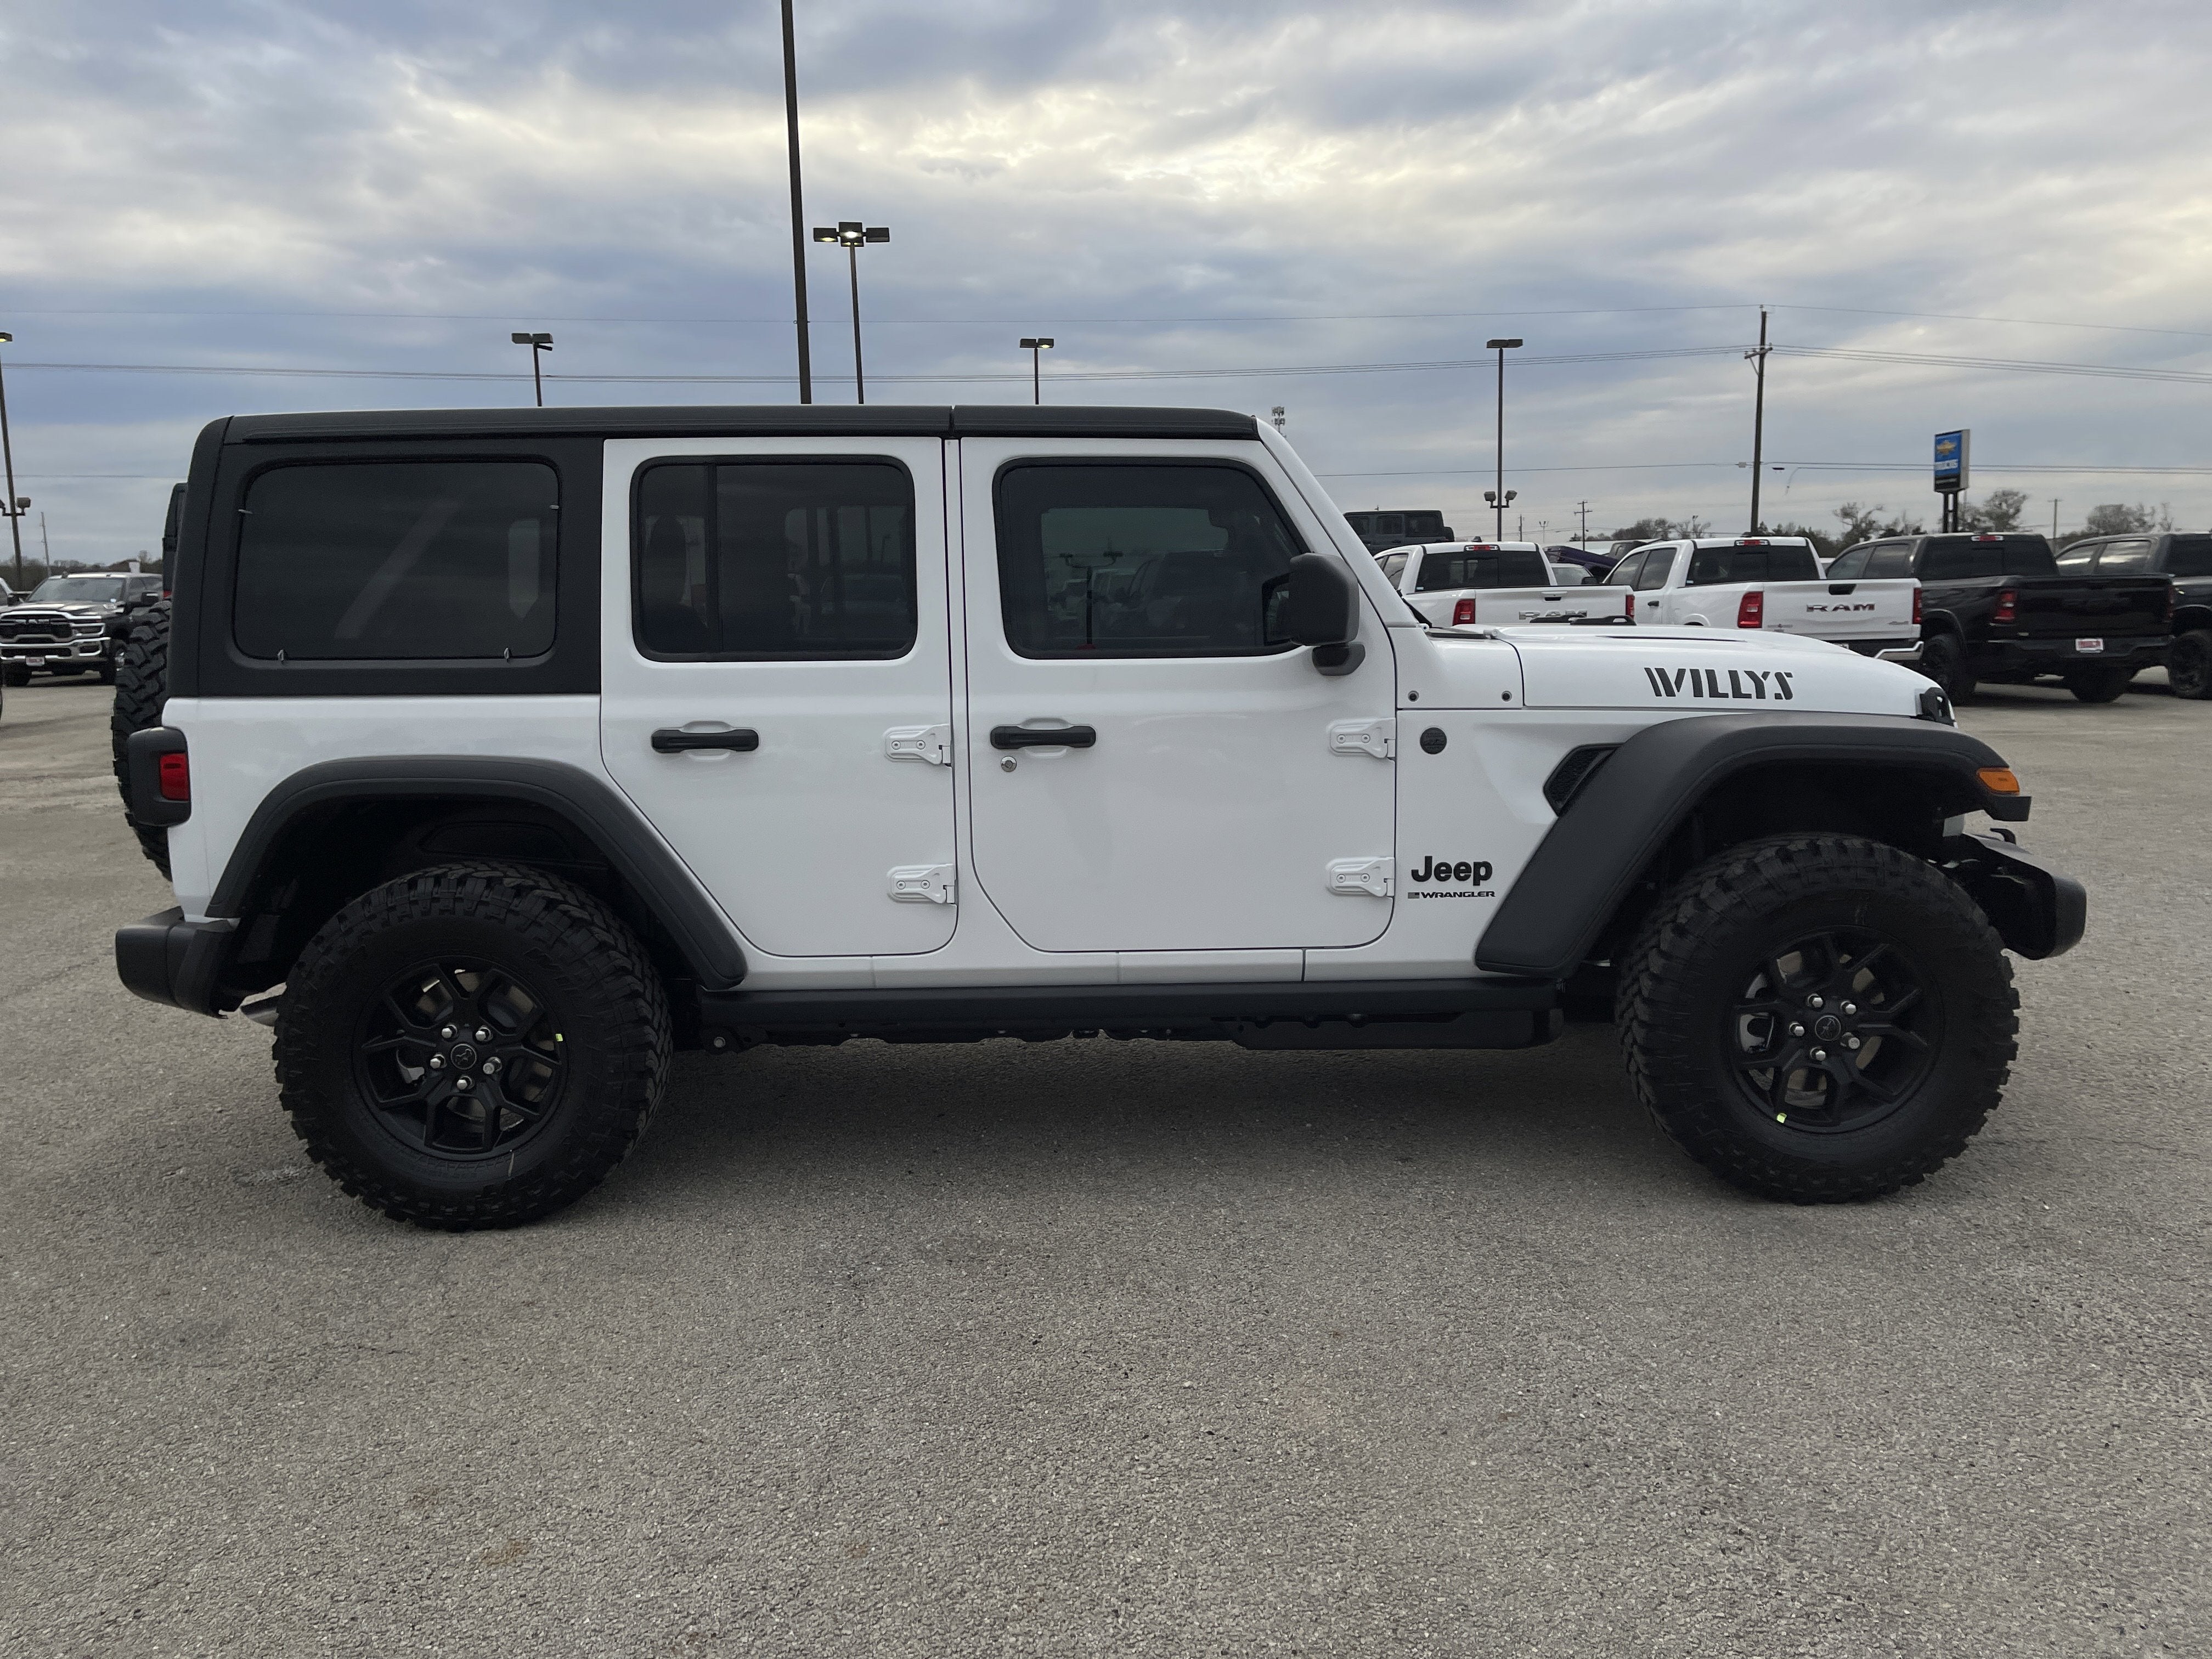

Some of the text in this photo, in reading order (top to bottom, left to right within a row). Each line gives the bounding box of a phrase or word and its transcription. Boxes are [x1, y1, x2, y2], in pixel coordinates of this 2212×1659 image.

[1806, 603, 1875, 612] RAM
[1644, 667, 1793, 700] WILLYS
[1411, 855, 1493, 886] Jeep
[1420, 890, 1496, 899] WRANGLER
